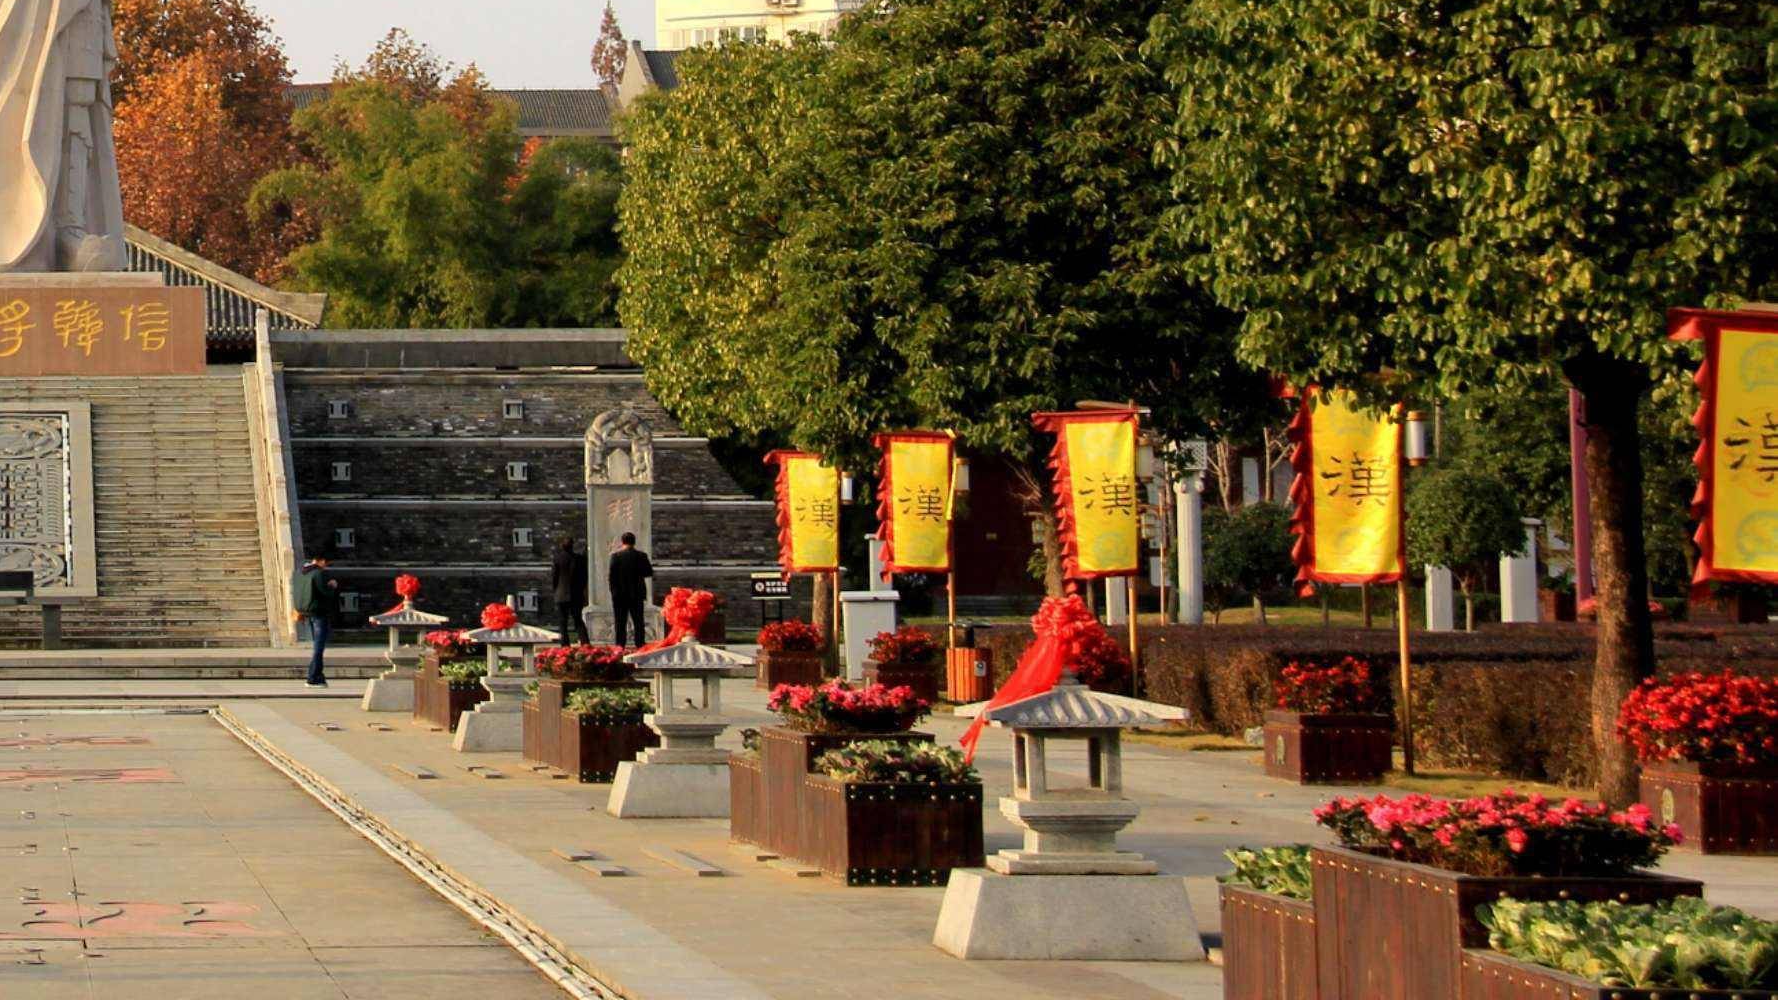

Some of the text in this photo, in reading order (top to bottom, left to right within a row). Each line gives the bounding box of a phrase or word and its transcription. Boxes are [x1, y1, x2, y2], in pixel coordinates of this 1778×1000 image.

[1078, 472, 1133, 516] 漢
[1321, 451, 1390, 506] 漢
[795, 495, 835, 528] 漢
[898, 484, 943, 522] 漢
